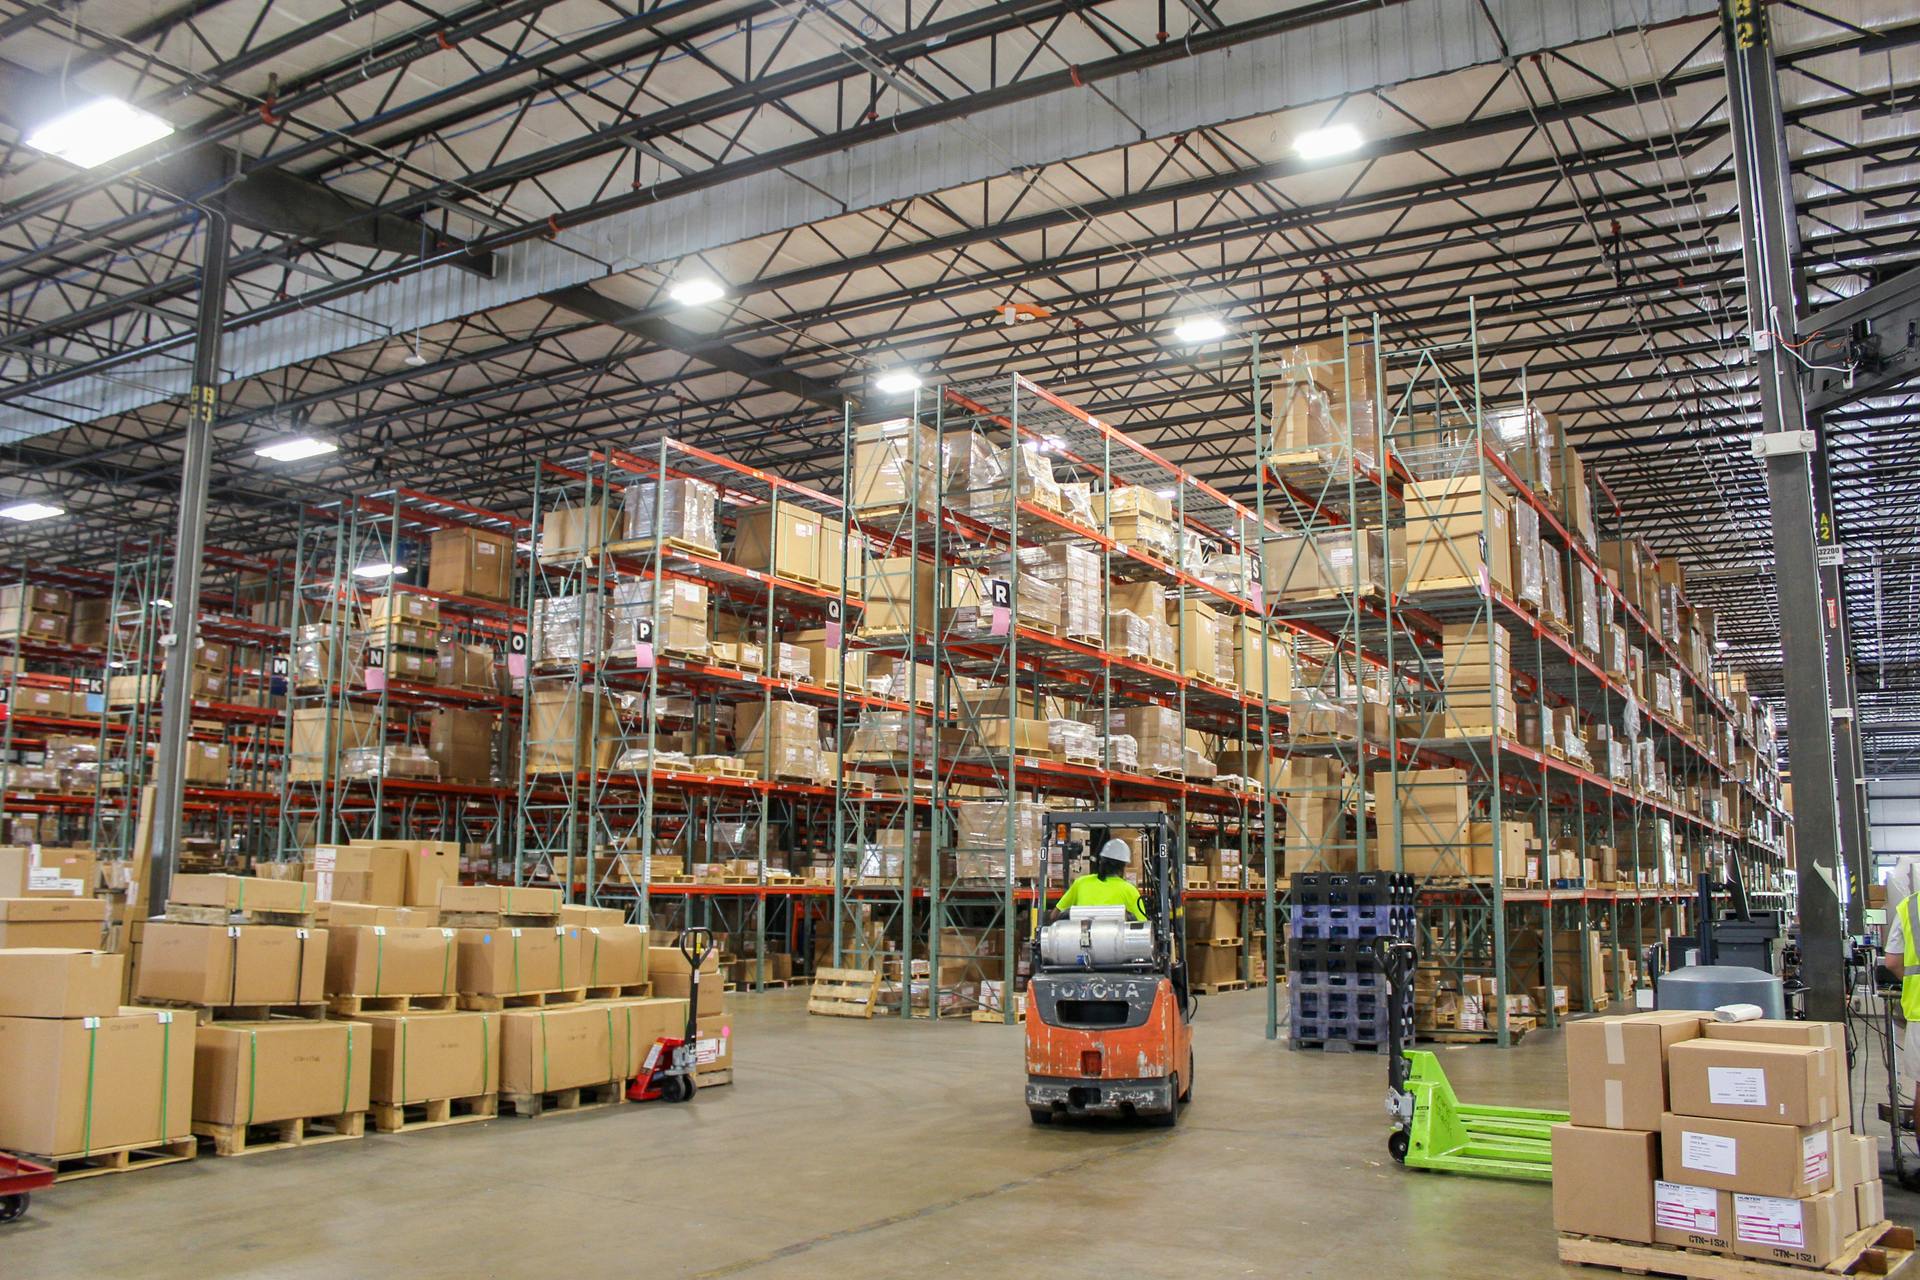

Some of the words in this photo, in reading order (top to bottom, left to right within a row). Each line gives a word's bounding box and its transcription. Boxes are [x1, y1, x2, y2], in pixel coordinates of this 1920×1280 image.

[1252, 559, 1260, 579] S
[995, 584, 1007, 604] R
[828, 601, 839, 618] Q
[640, 622, 650, 639] P
[370, 651, 382, 665] N
[274, 659, 287, 674] M
[91, 680, 102, 692] K
[1049, 983, 1140, 998] TOYOTA
[1773, 1248, 1816, 1263] CTN-1521
